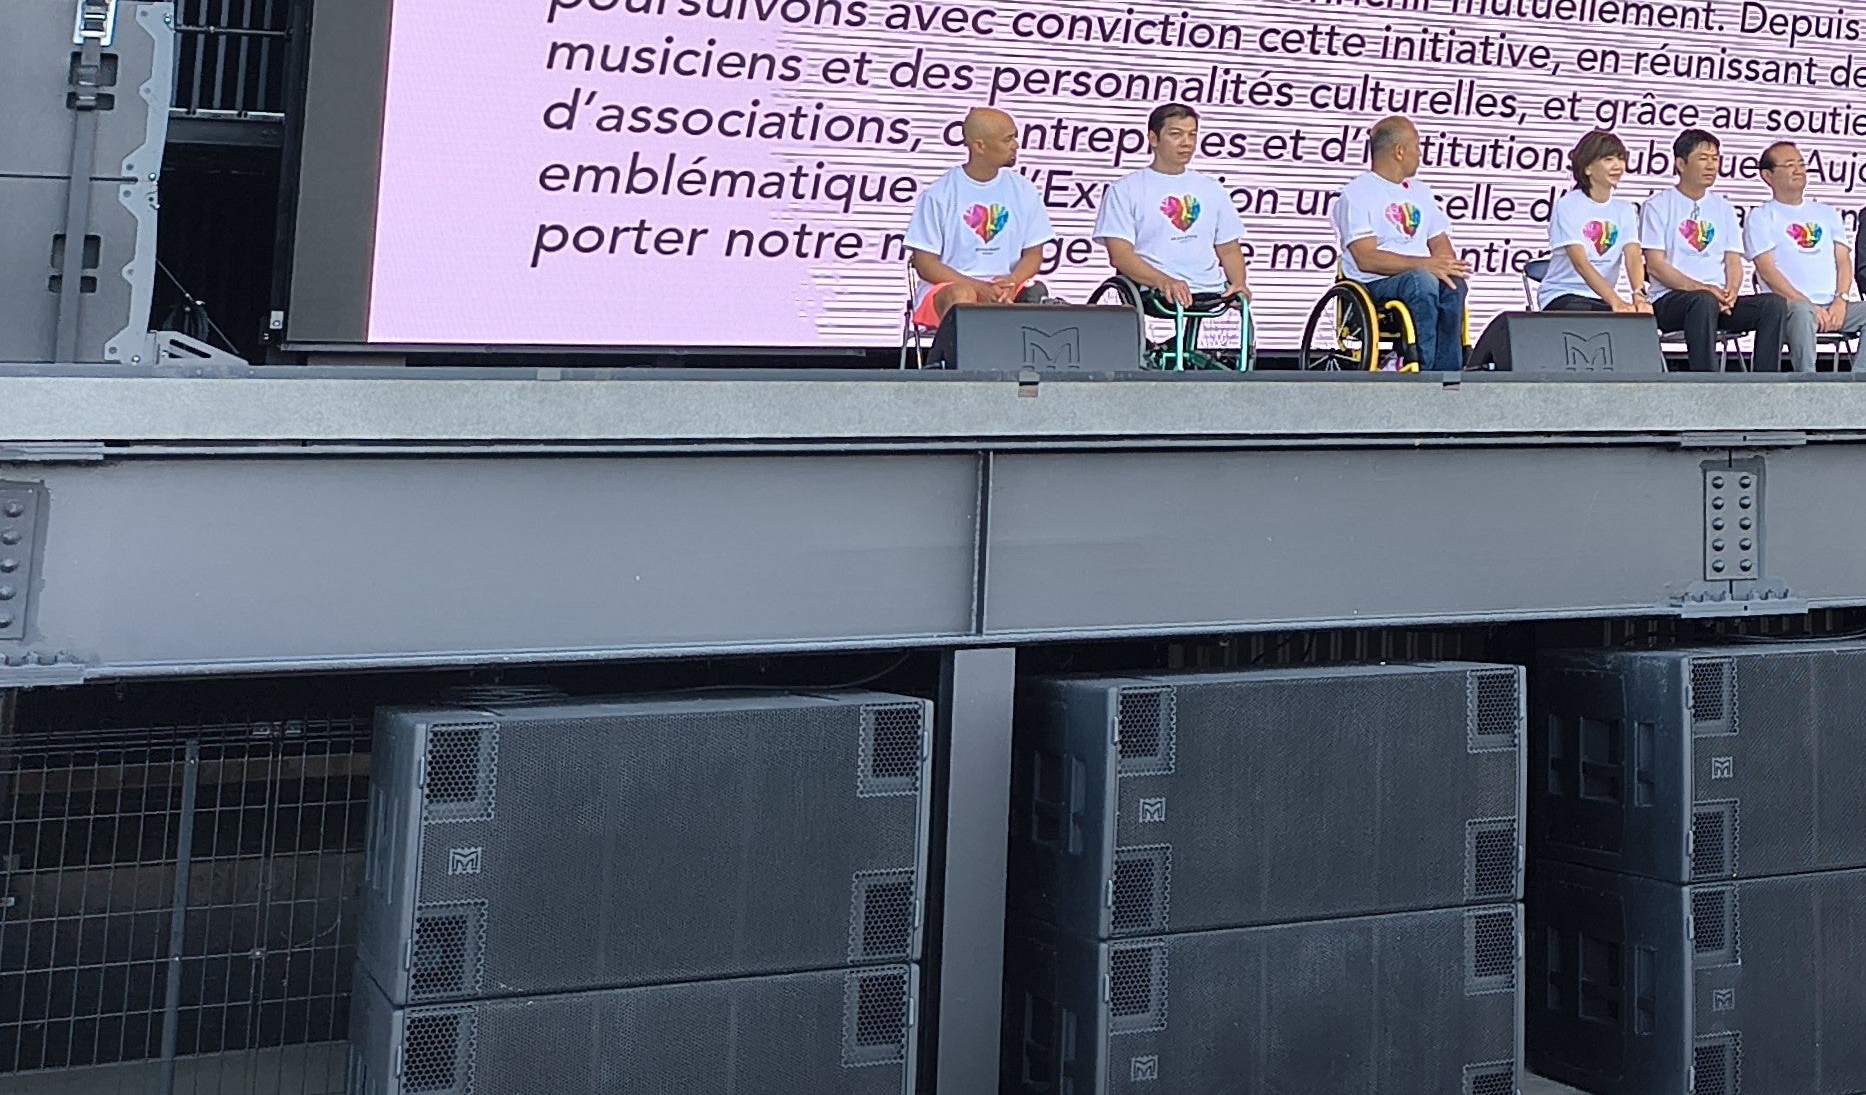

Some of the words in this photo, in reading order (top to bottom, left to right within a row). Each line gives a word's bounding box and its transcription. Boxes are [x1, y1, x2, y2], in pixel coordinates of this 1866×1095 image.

[883, 2, 998, 36] avec
[1011, 6, 1243, 52] conviction
[1257, 22, 1367, 58] cette
[1379, 23, 1561, 77] initiative,
[1575, 47, 1621, 75] en
[1633, 45, 1819, 86] réunissant
